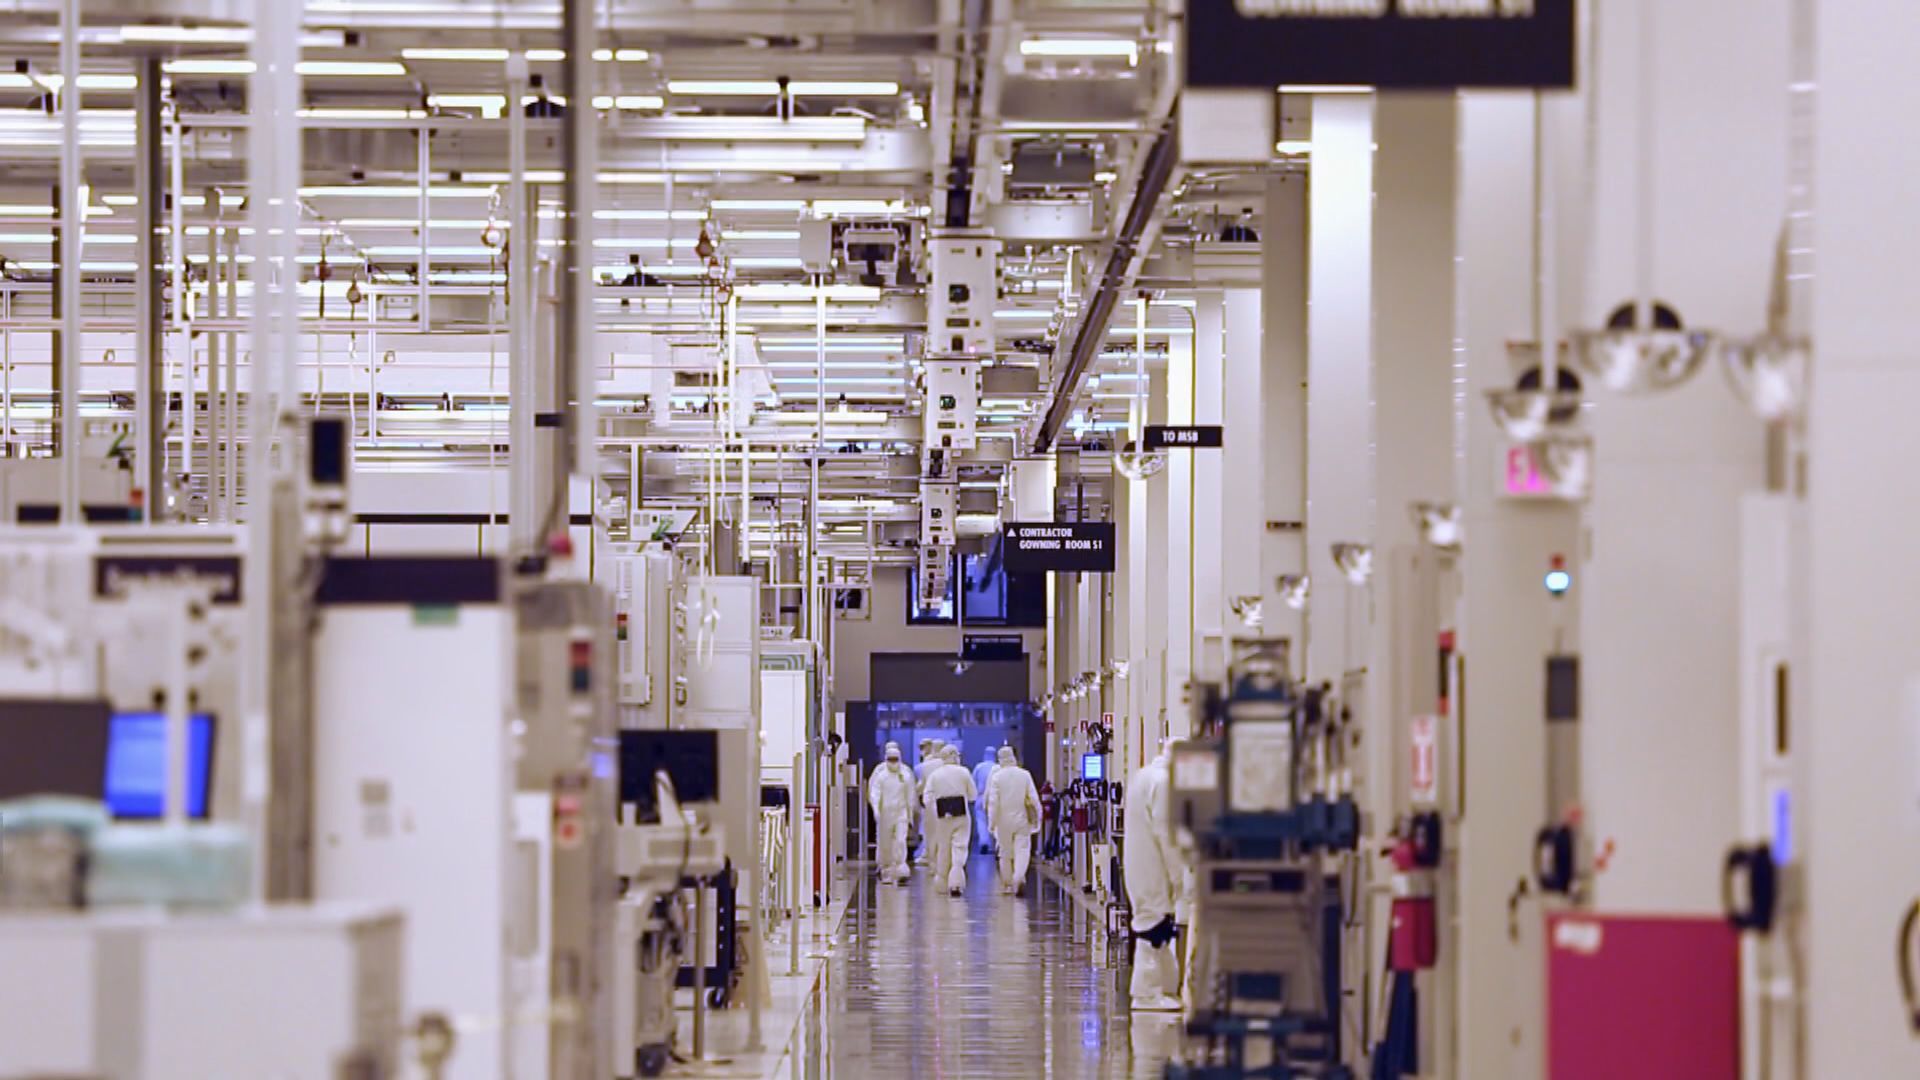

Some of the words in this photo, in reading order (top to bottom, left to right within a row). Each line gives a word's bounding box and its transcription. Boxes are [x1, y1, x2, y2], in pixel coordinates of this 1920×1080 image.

[1162, 430, 1176, 443] TO
[1019, 527, 1073, 538] CONTRACTOR
[1019, 540, 1061, 550] GOWNING
[1065, 540, 1092, 550] ROOM
